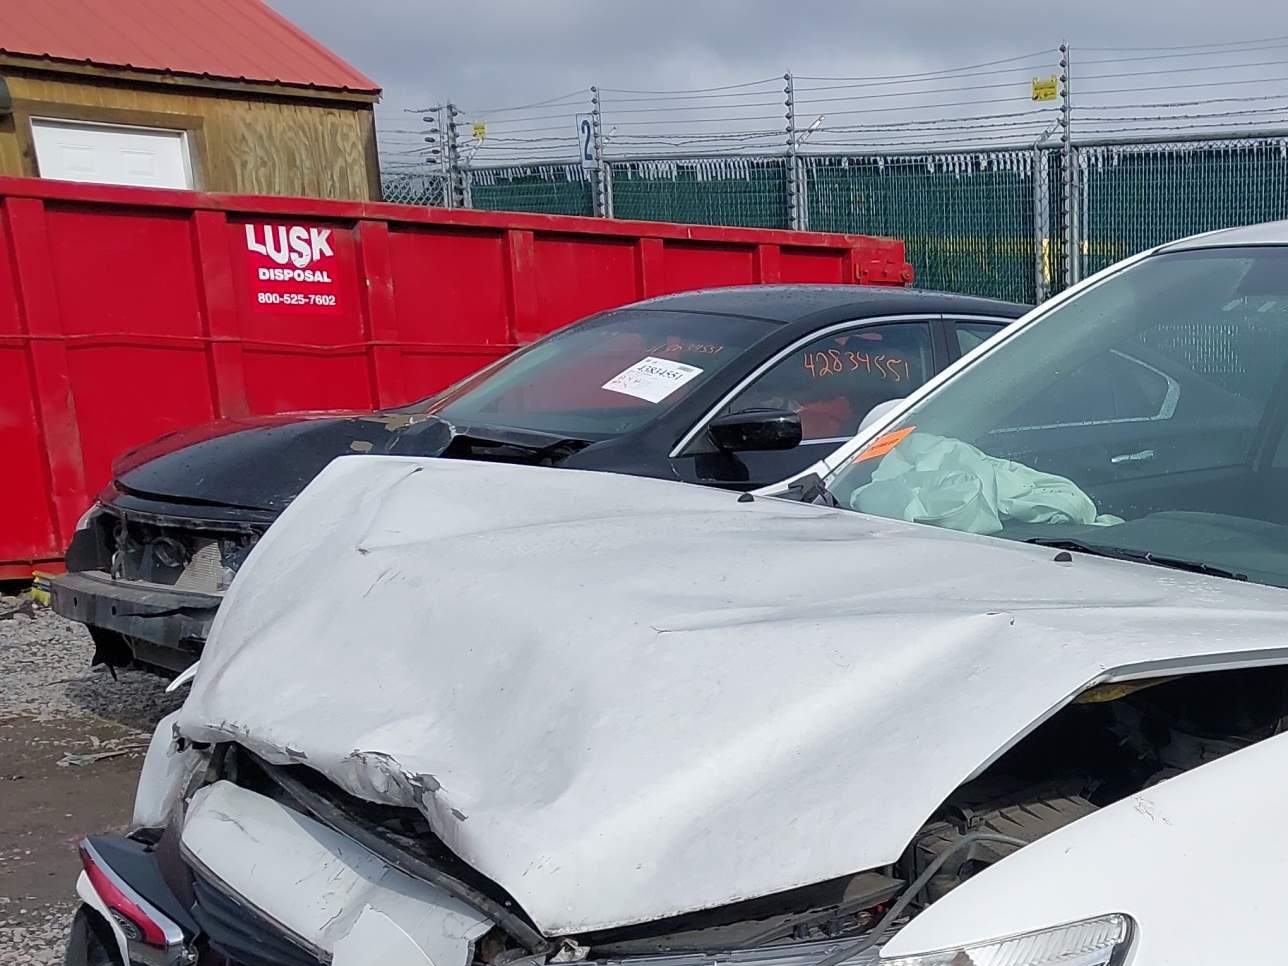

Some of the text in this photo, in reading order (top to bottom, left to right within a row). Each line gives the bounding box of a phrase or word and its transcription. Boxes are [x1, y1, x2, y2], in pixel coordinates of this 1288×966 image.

[581, 120, 594, 161] 2
[245, 223, 334, 268] LUSK
[258, 268, 332, 283] DISPOSAL
[257, 292, 336, 306] 800-525-7602
